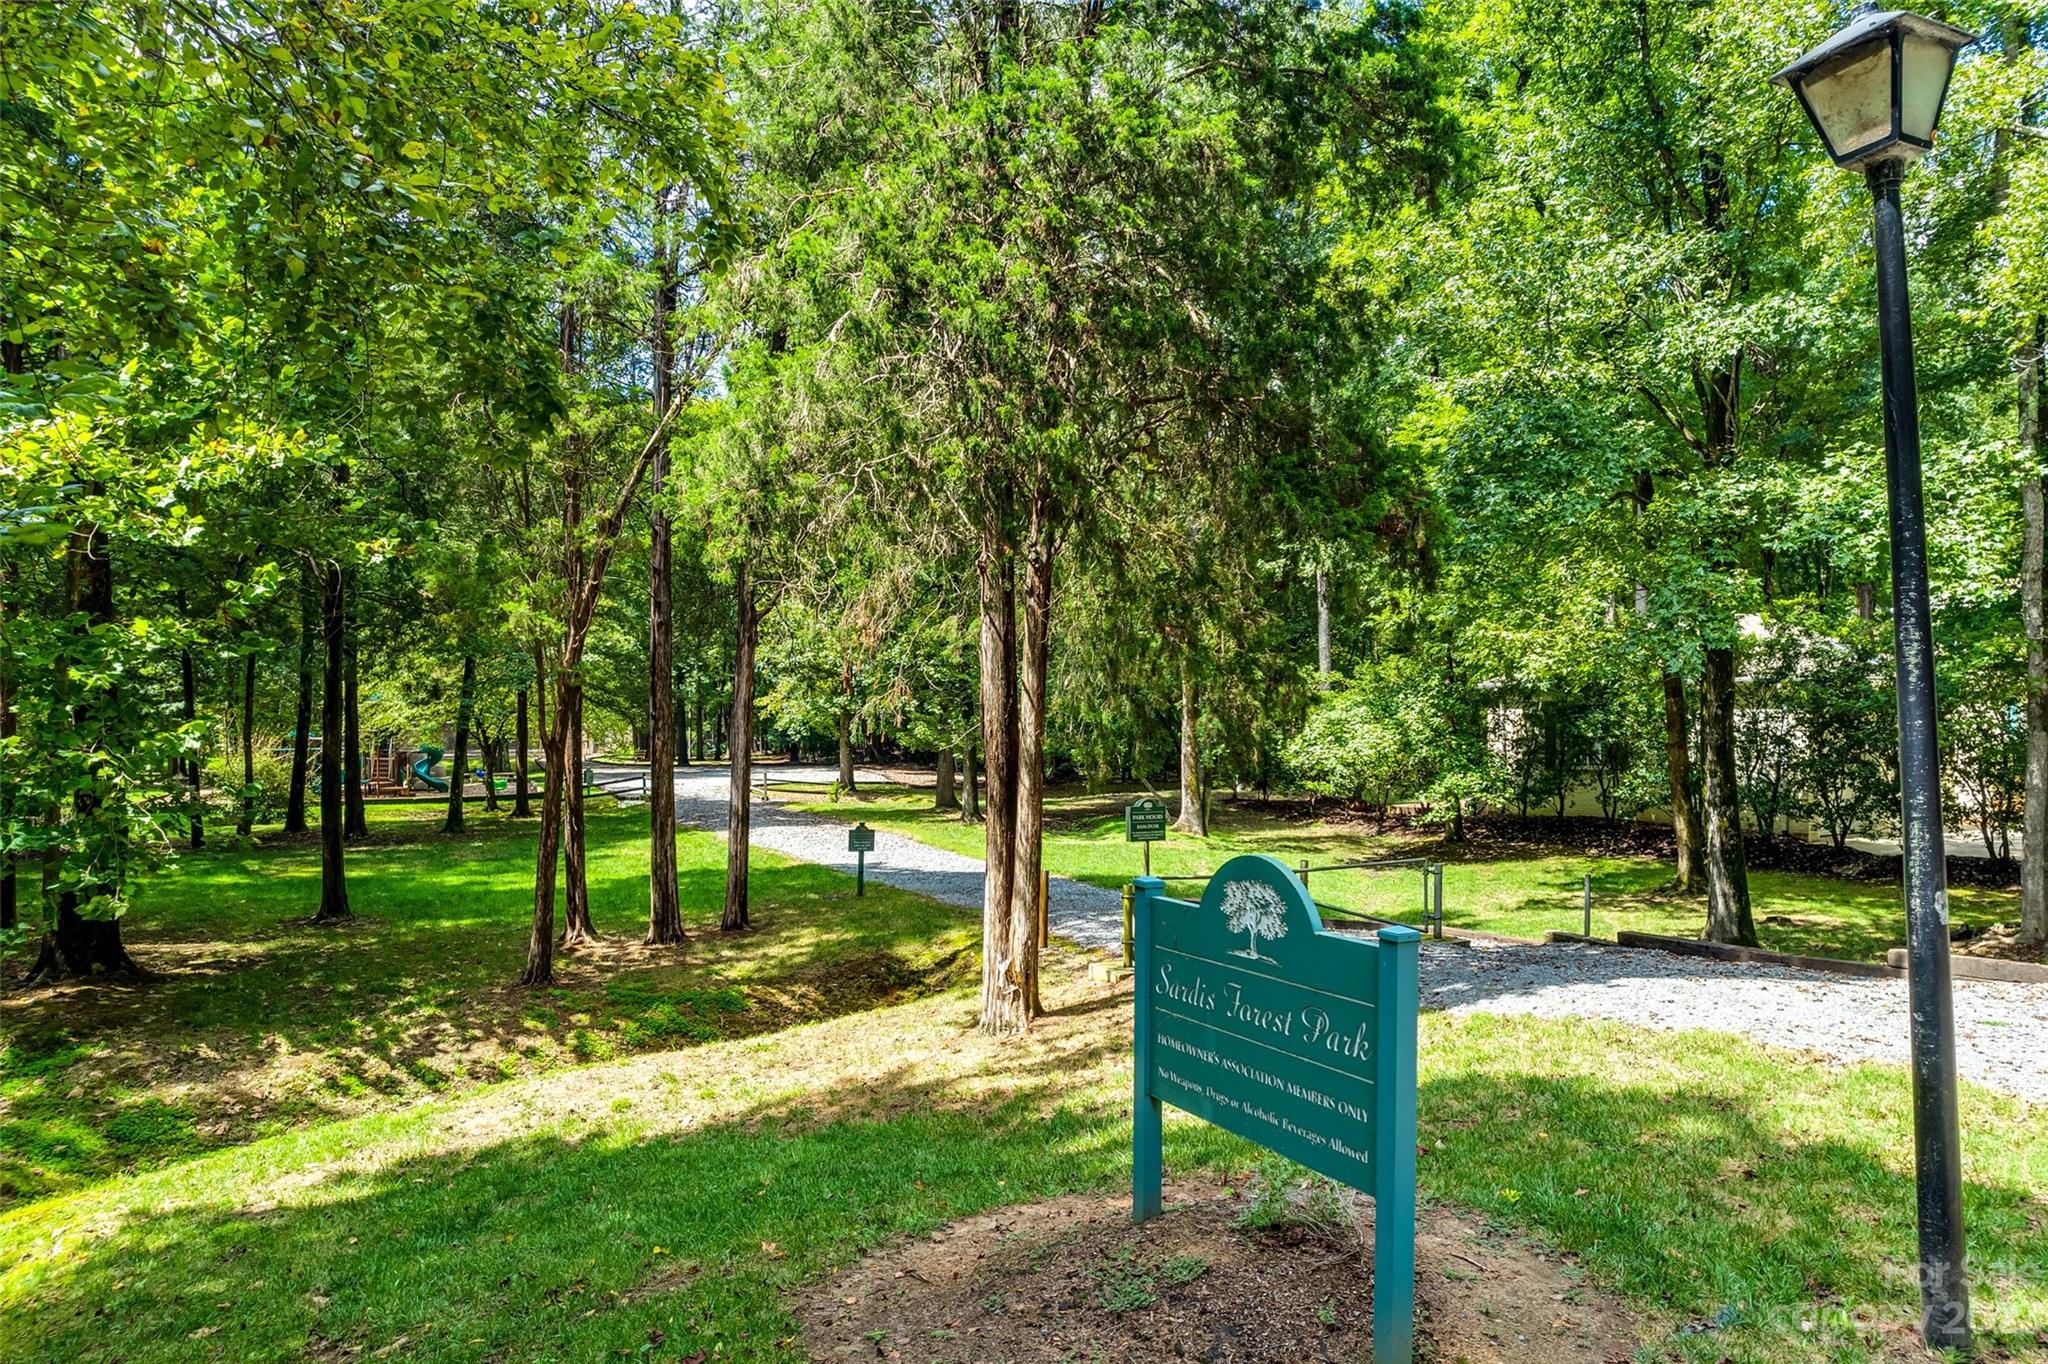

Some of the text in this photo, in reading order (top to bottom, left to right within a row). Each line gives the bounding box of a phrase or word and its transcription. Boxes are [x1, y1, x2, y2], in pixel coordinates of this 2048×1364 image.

[1155, 963, 1373, 1061] Sardis Forest Park
[1157, 1032, 1369, 1123] HOMEOWNER'S ASSOCIATION MEMBERS ONLY
[1157, 1066, 1368, 1164] No Weapons, Drugs or Alcoholic Beverages Allowed
